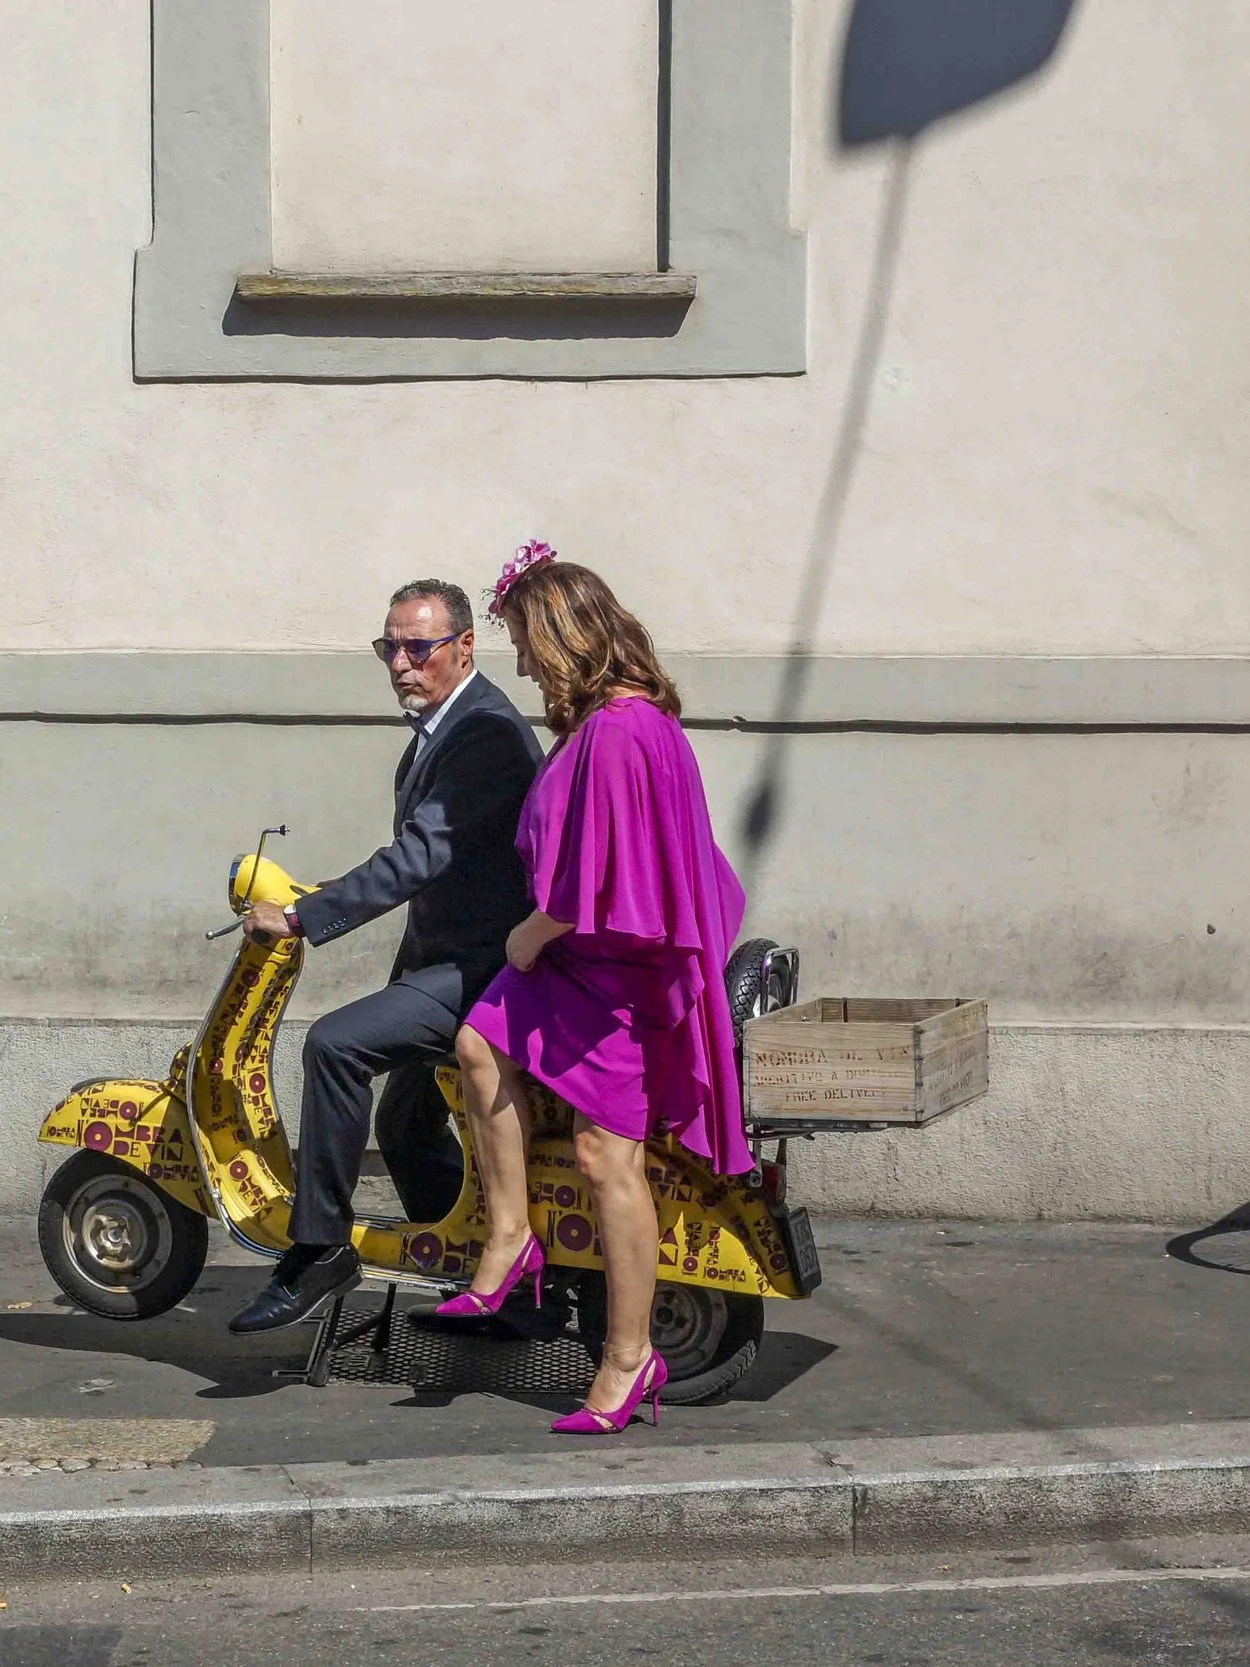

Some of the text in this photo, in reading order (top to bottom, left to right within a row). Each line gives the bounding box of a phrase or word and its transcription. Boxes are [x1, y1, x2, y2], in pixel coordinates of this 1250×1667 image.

[786, 1090, 816, 1102] FREE
[77, 1120, 183, 1153] N'OMBRA
[113, 1140, 183, 1162] DE VIN
